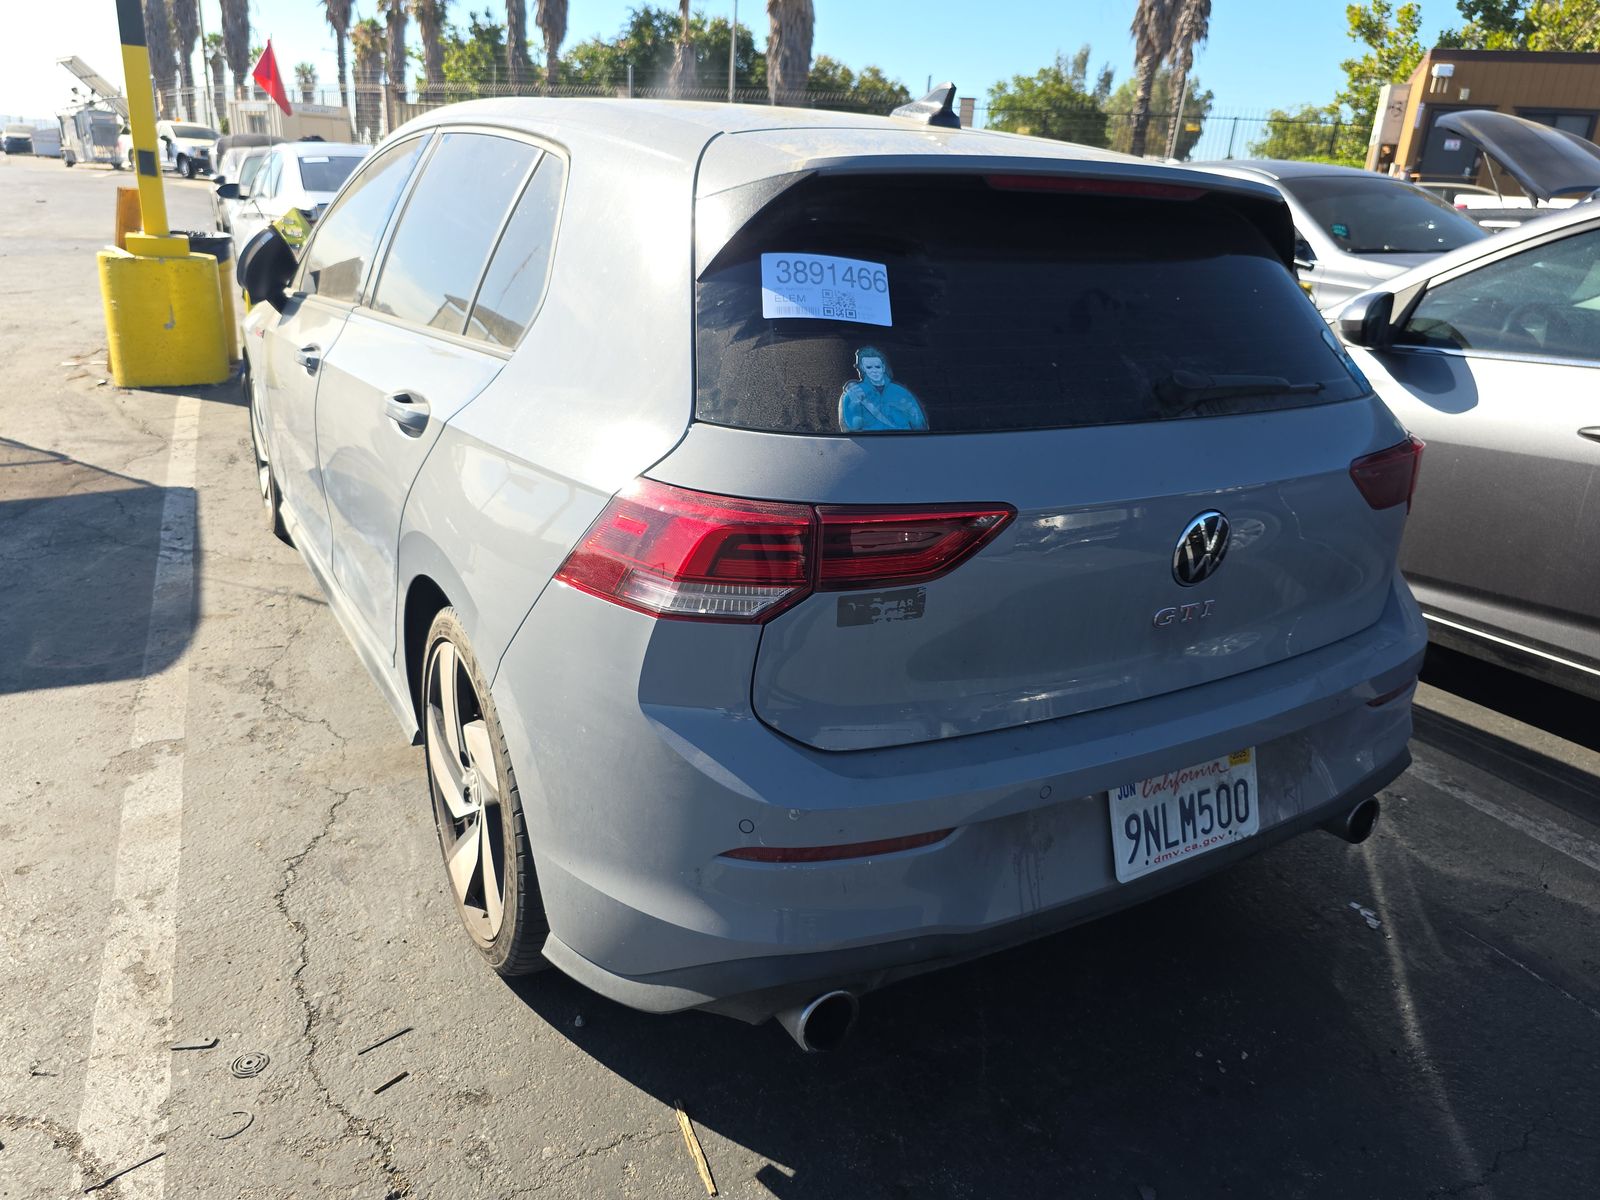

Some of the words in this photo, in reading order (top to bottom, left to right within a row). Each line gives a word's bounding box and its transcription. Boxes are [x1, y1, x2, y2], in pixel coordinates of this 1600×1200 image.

[776, 260, 887, 293] 3891466
[774, 293, 806, 303] ELEM
[1153, 600, 1216, 628] GTI
[1117, 783, 1137, 801] JUN
[1140, 760, 1230, 799] California
[1124, 778, 1250, 865] 9NLM500
[1153, 833, 1226, 865] dmv.ca.gov
